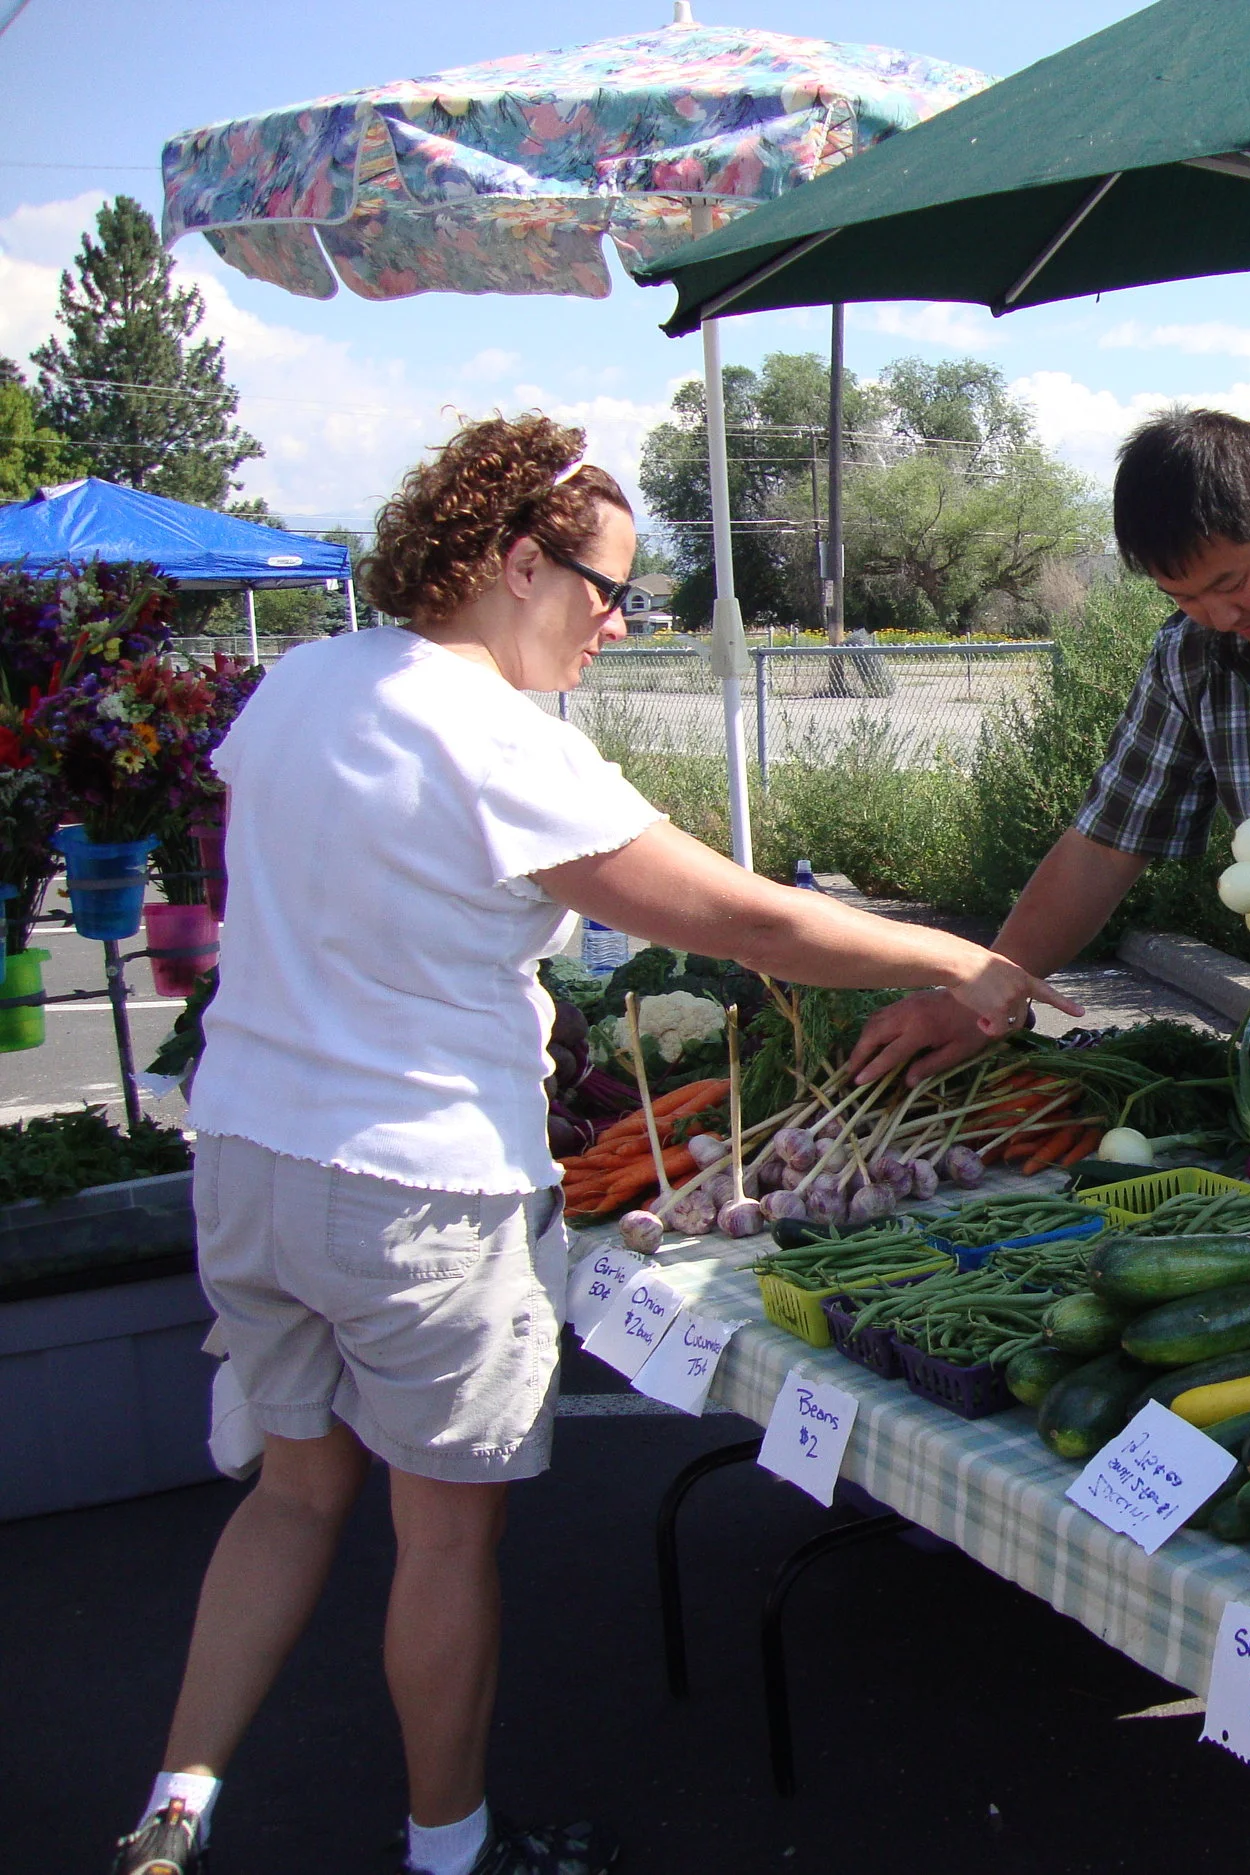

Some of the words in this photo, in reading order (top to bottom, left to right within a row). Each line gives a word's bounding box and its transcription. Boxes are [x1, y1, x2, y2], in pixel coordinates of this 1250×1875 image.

[594, 1256, 625, 1283] Garlic
[632, 1286, 665, 1317] Onion
[797, 1388, 839, 1430] Beans
[799, 1425, 818, 1458] $2
